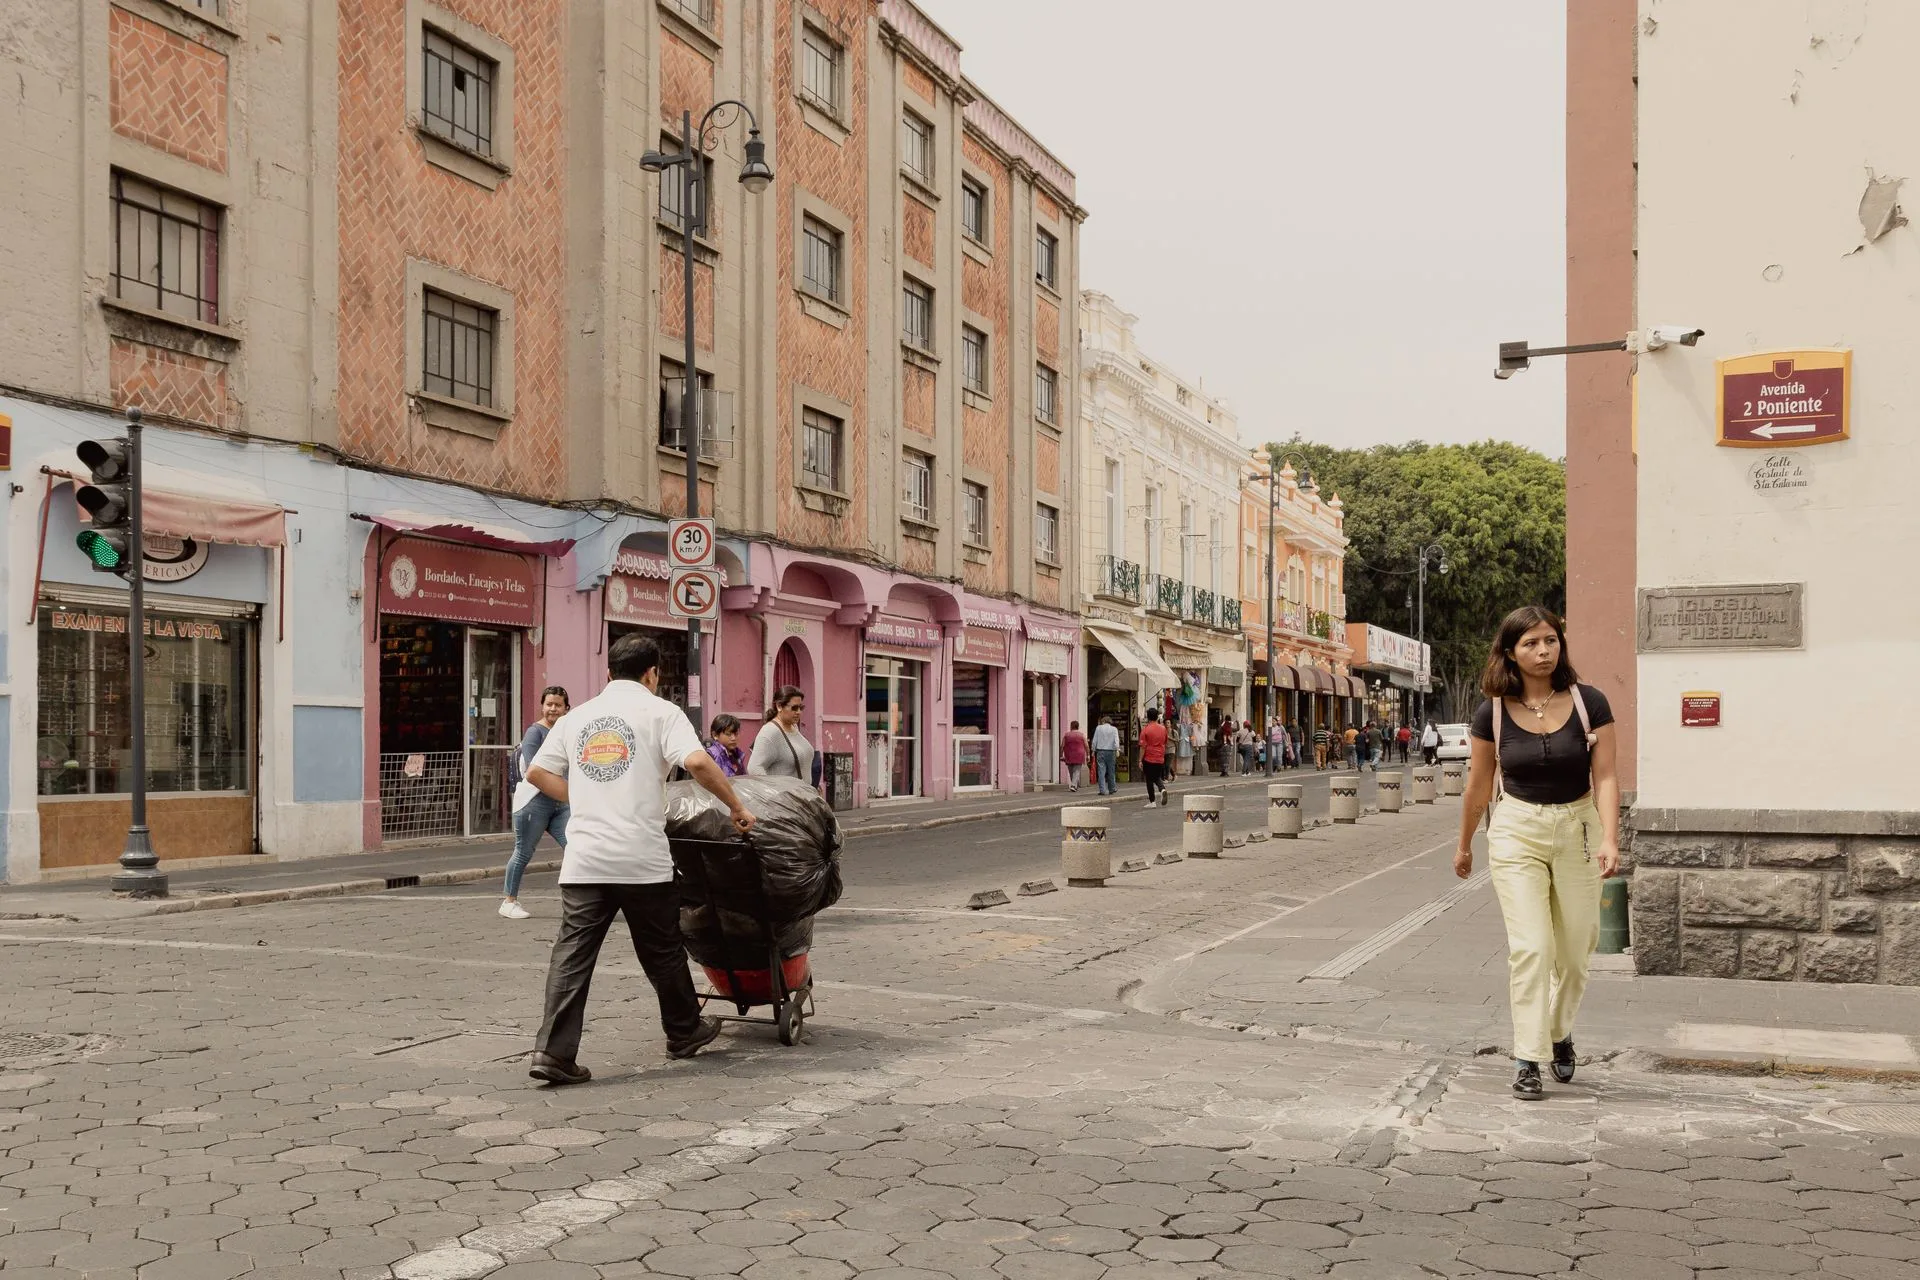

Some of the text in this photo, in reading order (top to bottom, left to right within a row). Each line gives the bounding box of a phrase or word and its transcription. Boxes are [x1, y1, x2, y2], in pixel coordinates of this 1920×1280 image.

[1760, 382, 1805, 396] Avenida
[1743, 397, 1822, 416] 2 Poniente
[1764, 456, 1792, 468] Calle
[683, 529, 702, 544] 30
[144, 563, 197, 578] ERICANA
[617, 552, 659, 573] ORDADOS,
[425, 567, 468, 586] Bordados,
[469, 573, 499, 592] Encajes
[505, 578, 526, 593] Telas
[685, 581, 704, 607] E
[1677, 598, 1762, 612] IGLESIA
[52, 612, 125, 633] EXAMEN
[155, 620, 175, 637] LA
[176, 621, 223, 640] VISTA
[1654, 610, 1788, 627] METODISTA EPISCOPAL
